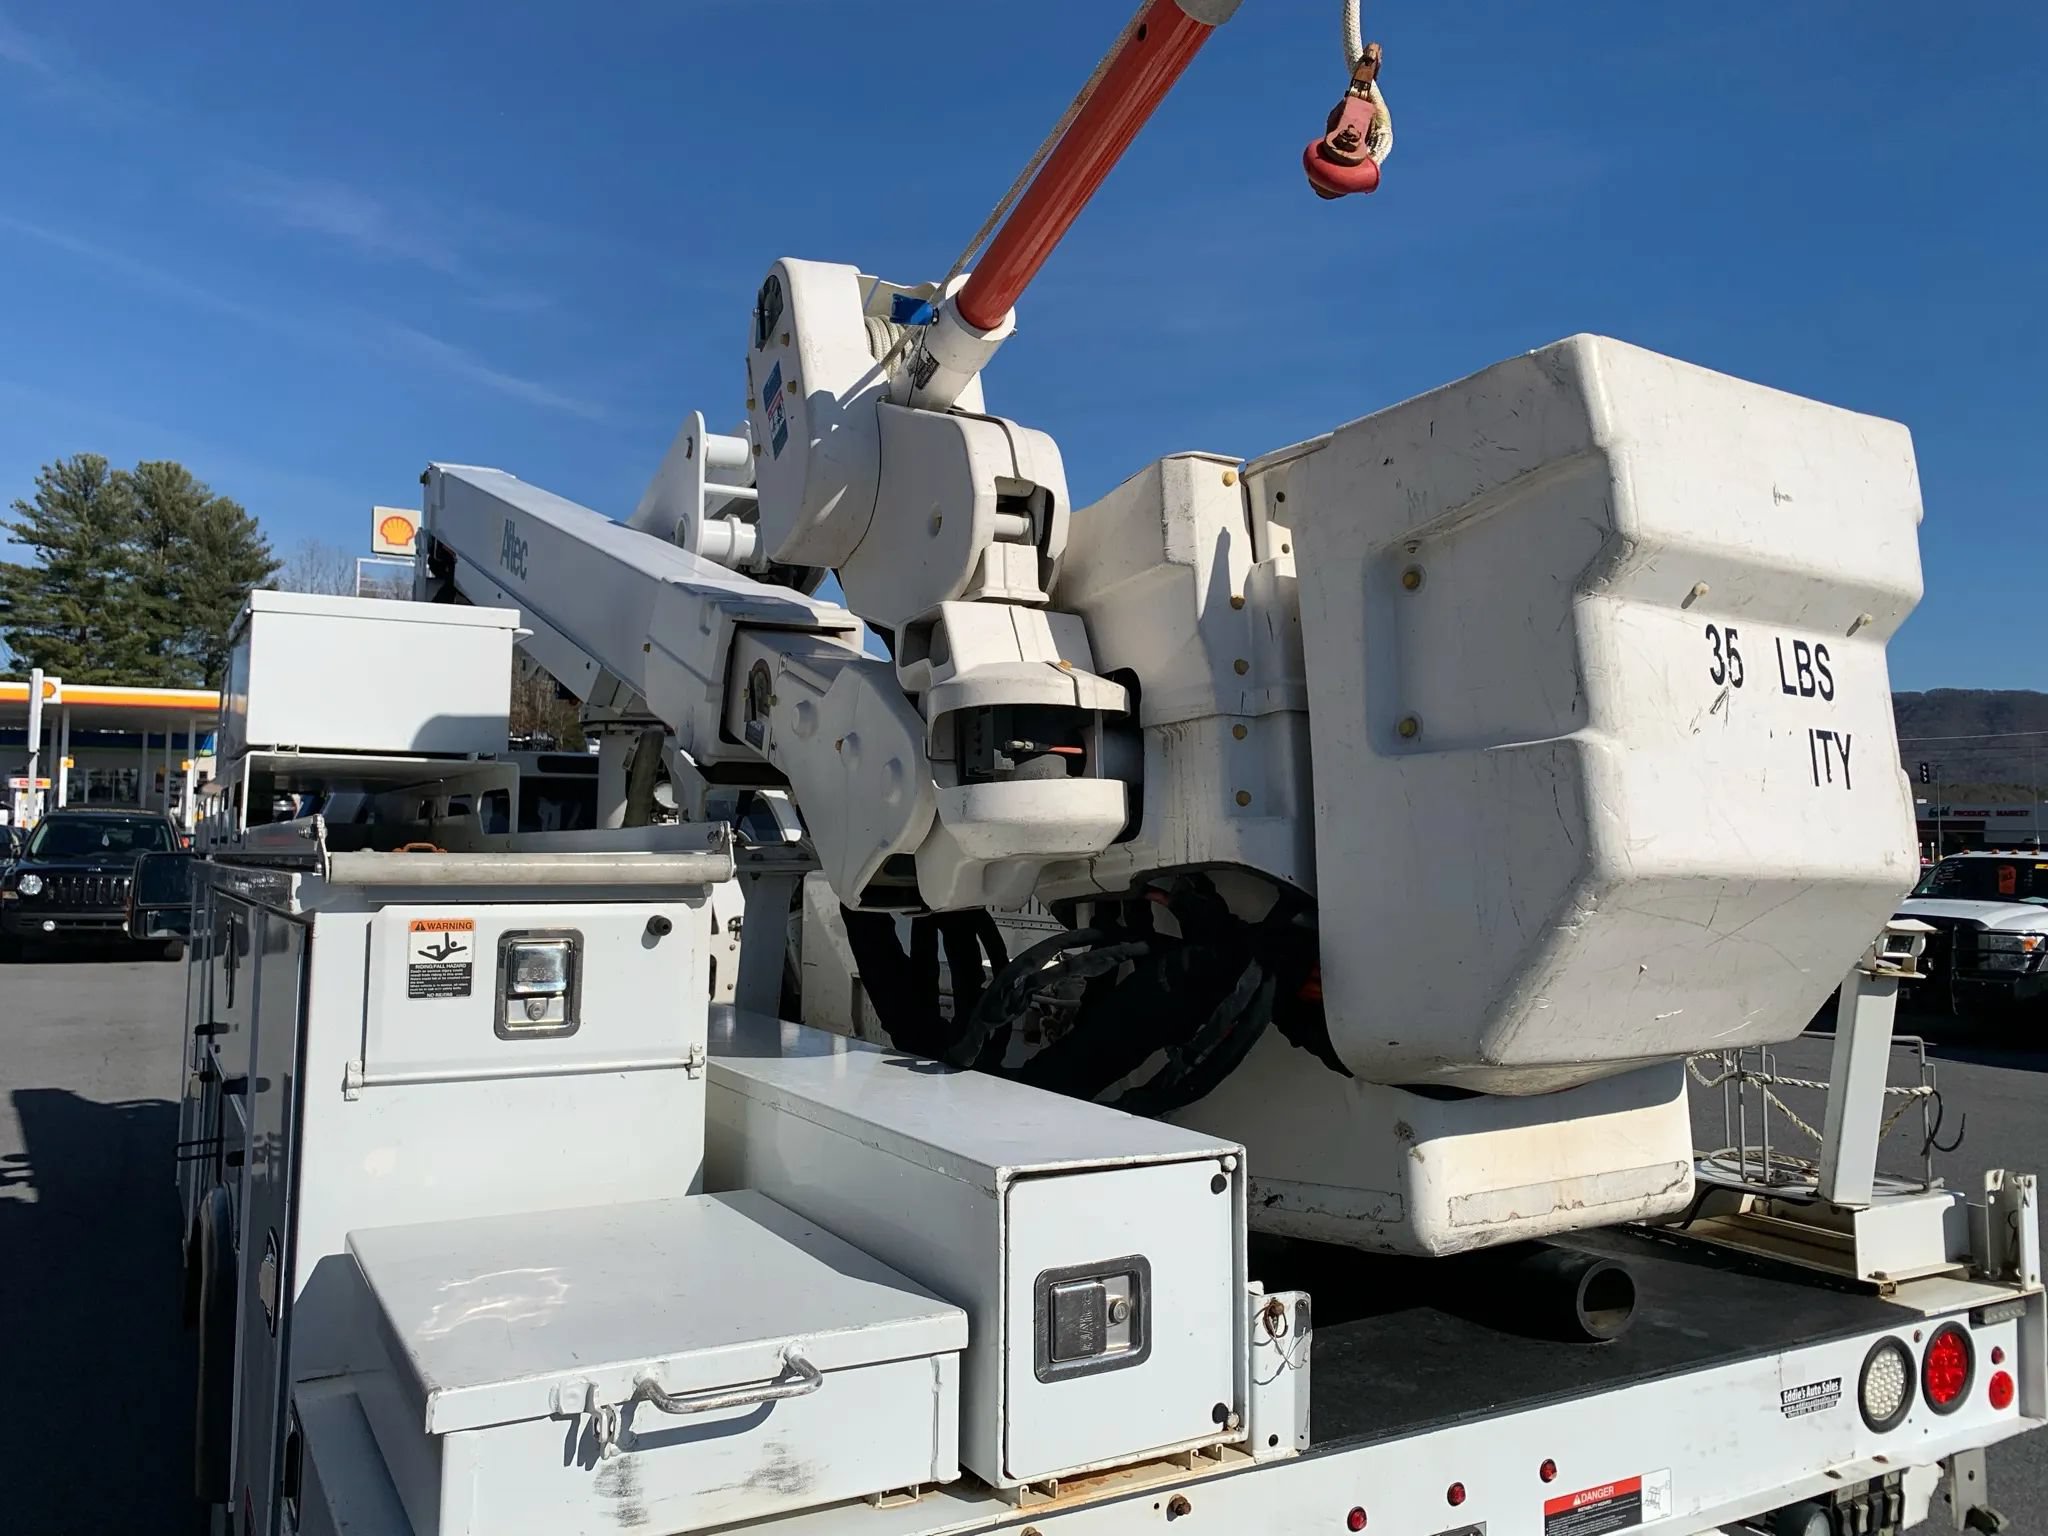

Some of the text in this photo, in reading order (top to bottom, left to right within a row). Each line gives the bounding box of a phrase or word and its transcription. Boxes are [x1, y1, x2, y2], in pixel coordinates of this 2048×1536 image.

[500, 519, 528, 581] Altec
[1775, 637, 1834, 701] LBS
[427, 922, 472, 930] WARNING
[1784, 1381, 1838, 1403] Eddie's Auto Sales
[1581, 1486, 1614, 1503] DANGER
